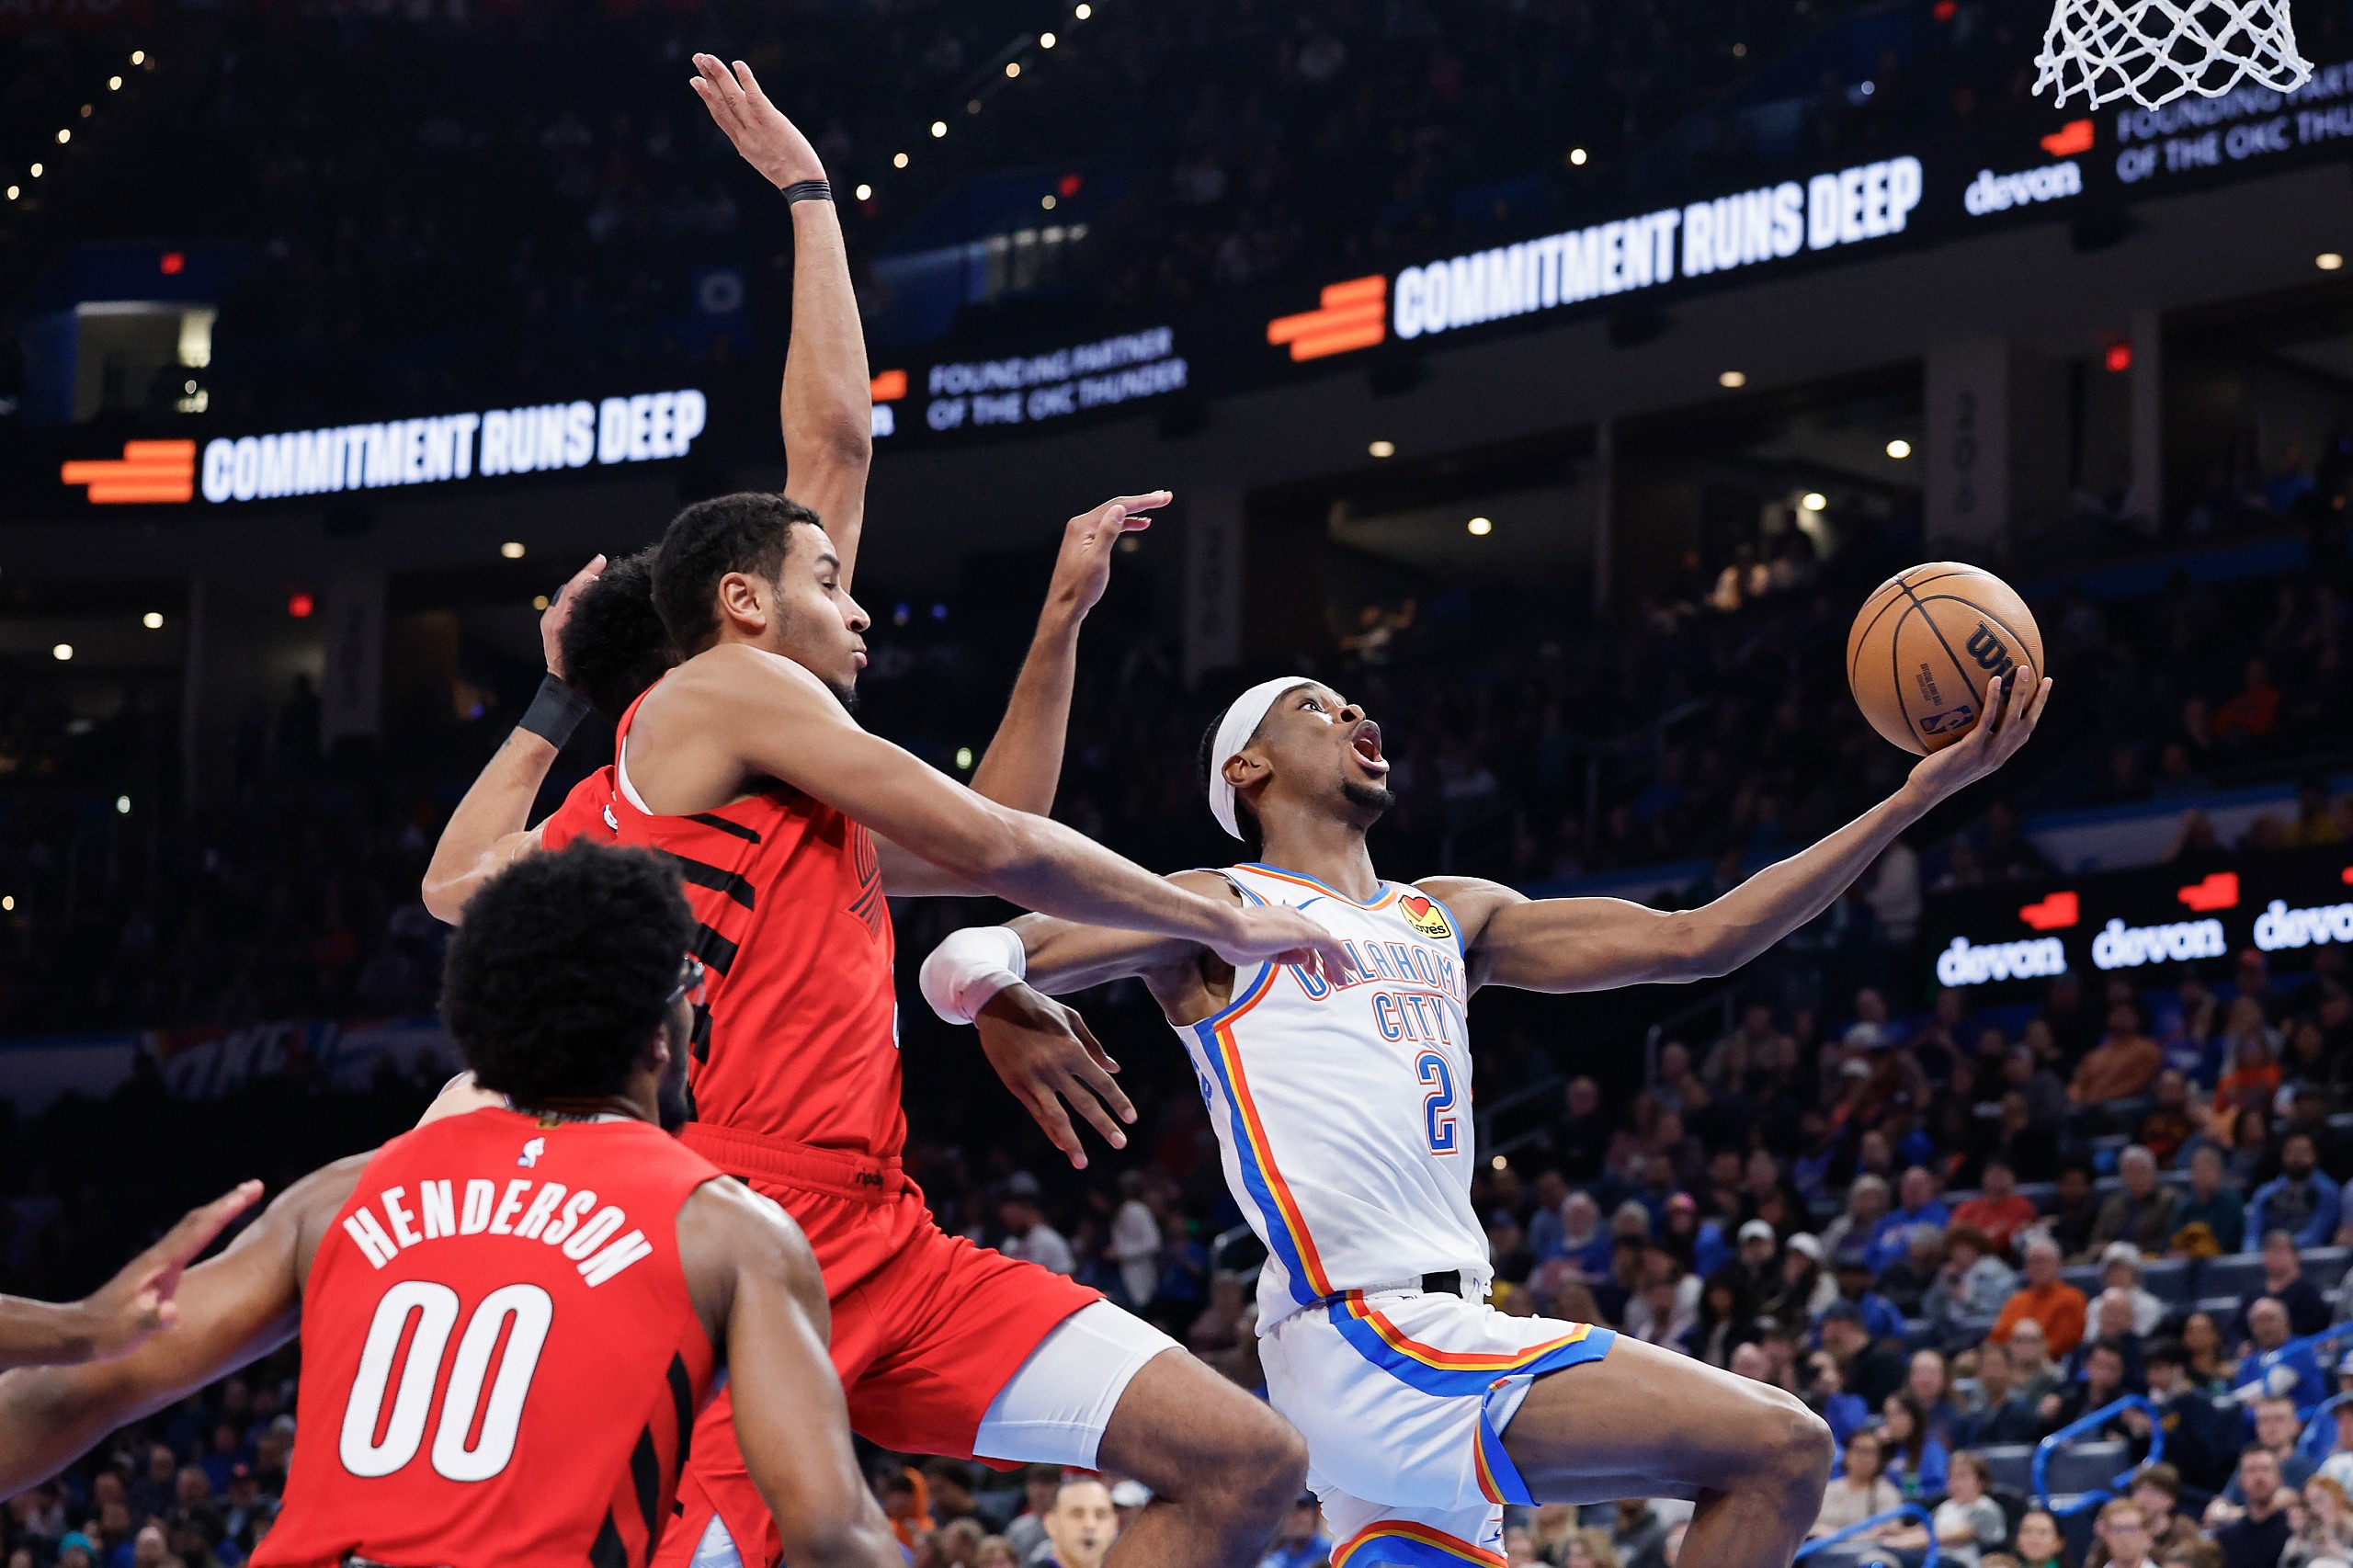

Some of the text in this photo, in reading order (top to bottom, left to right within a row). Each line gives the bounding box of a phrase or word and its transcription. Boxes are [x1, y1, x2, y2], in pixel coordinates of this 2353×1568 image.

[1964, 161, 2083, 217] devon
[2116, 143, 2157, 183] OF
[2165, 130, 2221, 173] THE
[1392, 154, 1922, 340] COMMITMENT RUNS DEEP
[926, 396, 965, 431] OF
[972, 390, 1025, 426] THE
[1078, 357, 1187, 408] THUNDER
[201, 389, 707, 504] COMMITMENT RUNS DEEP
[2092, 918, 2226, 970] devon
[2254, 899, 2353, 951] devo
[1937, 936, 2067, 987] devon
[1371, 991, 1451, 1045] CITY
[1415, 1050, 1459, 1156] 2
[342, 1178, 654, 1288] HENDERSON
[338, 1279, 553, 1483] 00
